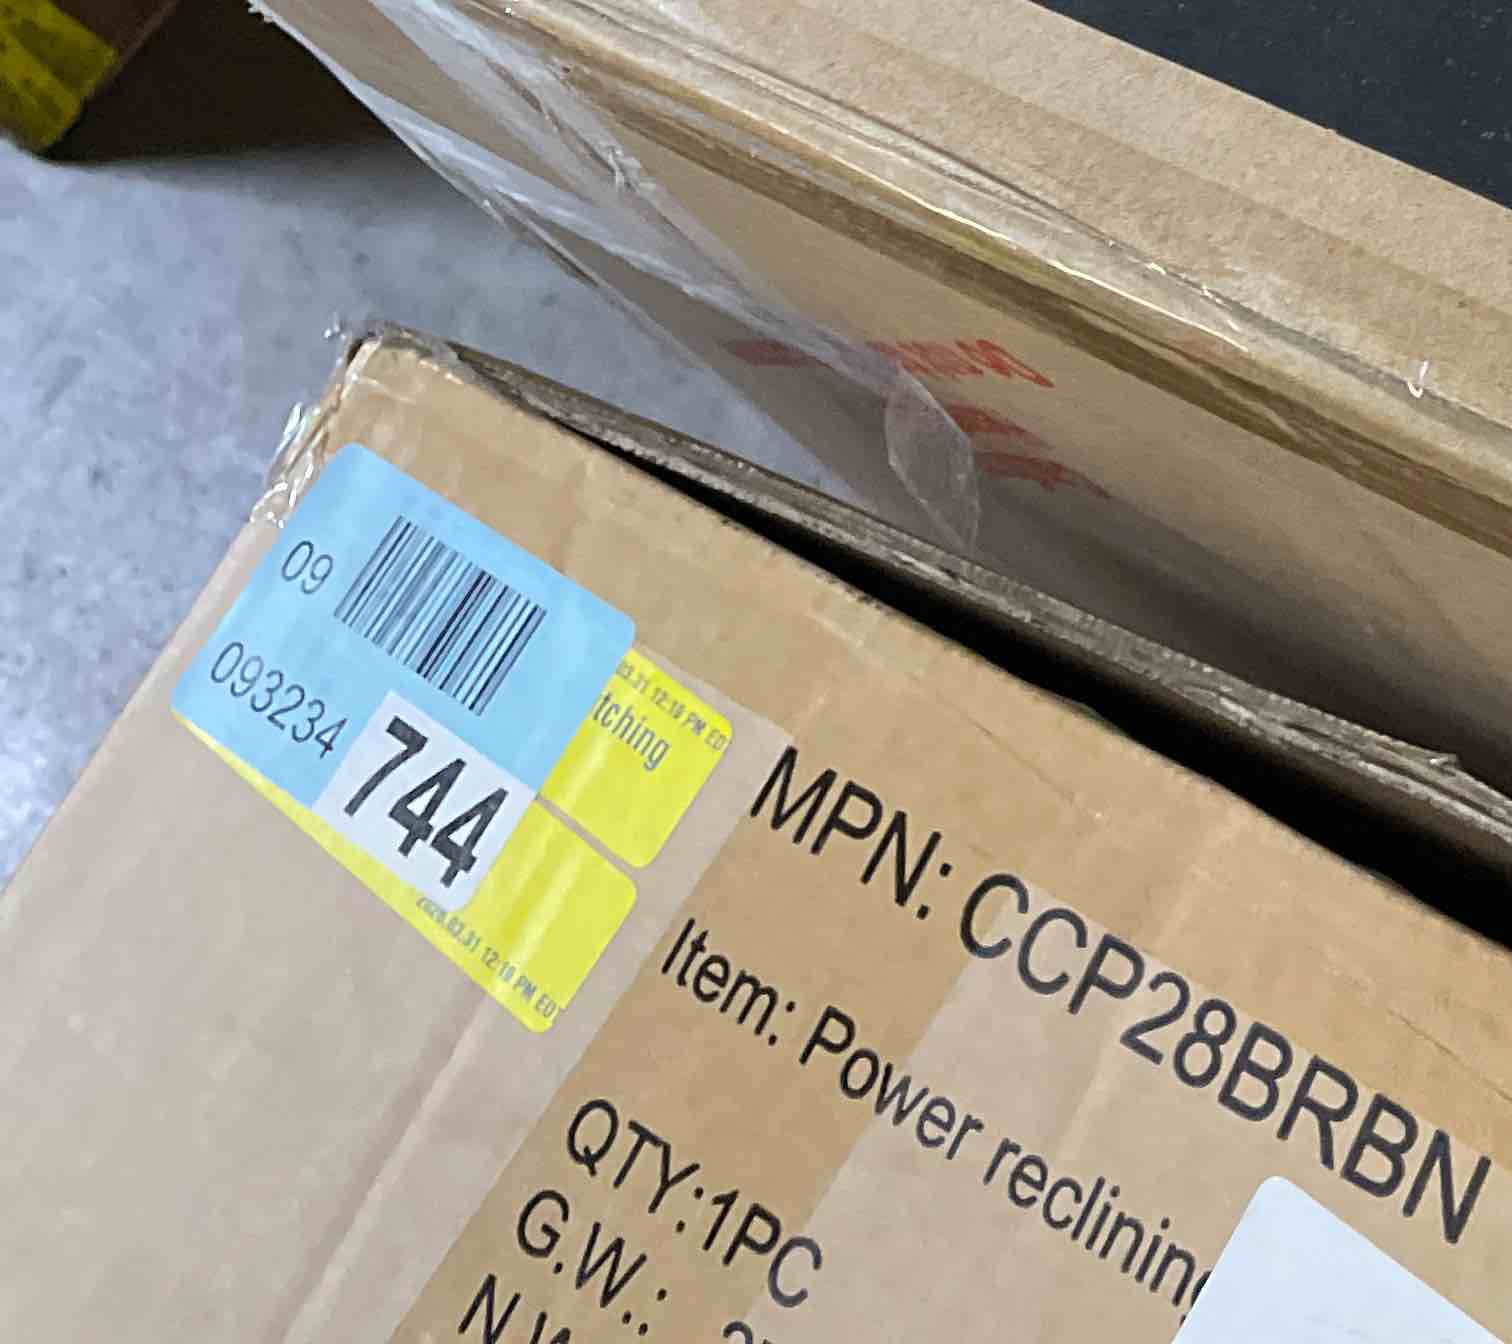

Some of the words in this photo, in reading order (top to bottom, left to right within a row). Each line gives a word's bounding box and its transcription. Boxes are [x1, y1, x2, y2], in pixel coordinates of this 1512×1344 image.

[280, 540, 334, 595] 09
[210, 641, 348, 759] 093234
[343, 714, 509, 889] 744
[661, 917, 804, 1047] Item:
[799, 1005, 984, 1162] Power
[750, 746, 953, 919] MPN:
[958, 872, 1492, 1245] CCP28BRBN
